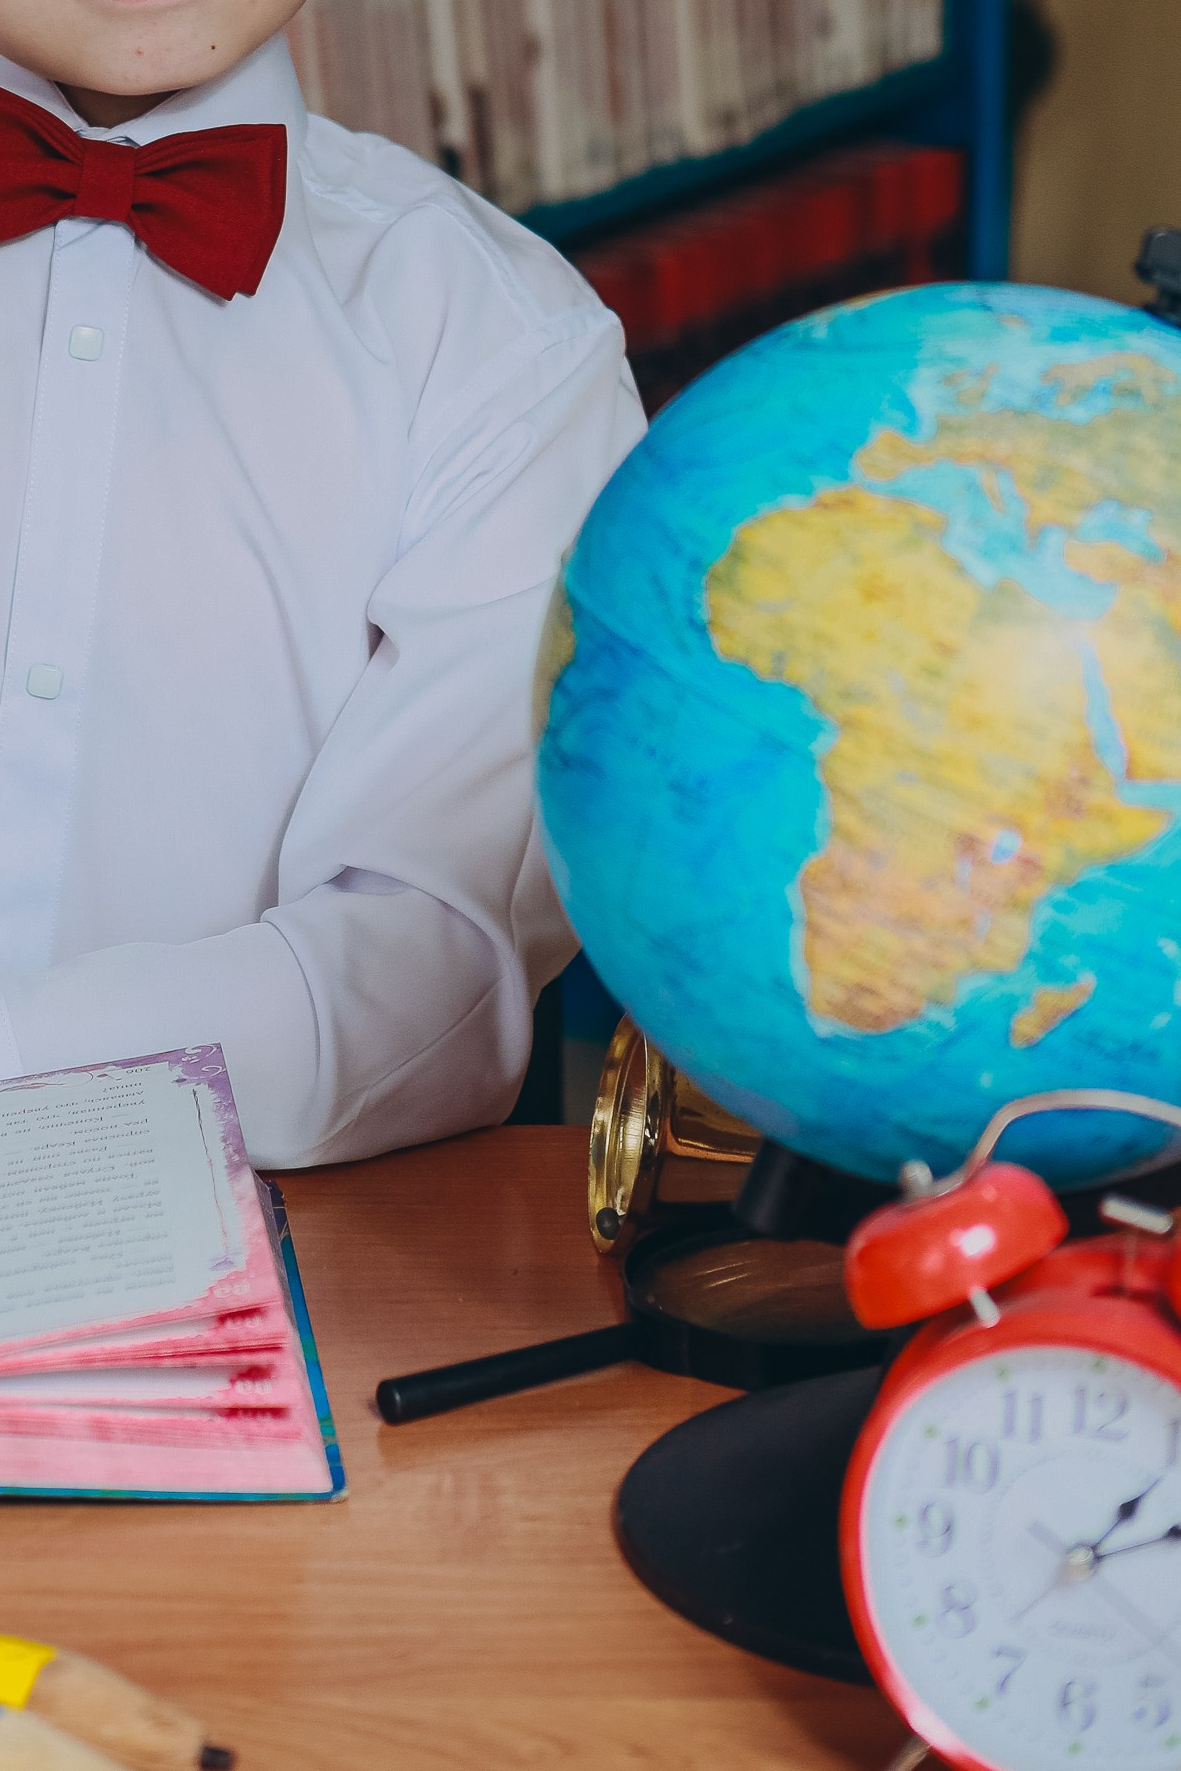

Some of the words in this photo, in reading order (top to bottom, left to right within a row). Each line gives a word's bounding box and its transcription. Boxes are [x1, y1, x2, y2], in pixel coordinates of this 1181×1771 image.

[103, 1082, 142, 1092] ница?
[67, 1099, 145, 1115] уверенная,
[38, 1116, 103, 1130] Конечно,
[70, 1124, 118, 1135] носом.
[84, 1130, 150, 1143] спросила
[30, 1141, 76, 1151] Кедра.
[69, 1146, 108, 1155] Разве
[108, 1148, 153, 1159] ваться
[3, 1161, 76, 1177] сторонам.
[1003, 1387, 1043, 1443] 11
[1074, 1385, 1129, 1441] 12
[945, 1437, 1000, 1494] 10
[918, 1500, 955, 1556] 9
[937, 1581, 977, 1638] 8
[990, 1645, 1027, 1696] 7
[1057, 1678, 1098, 1731] 6
